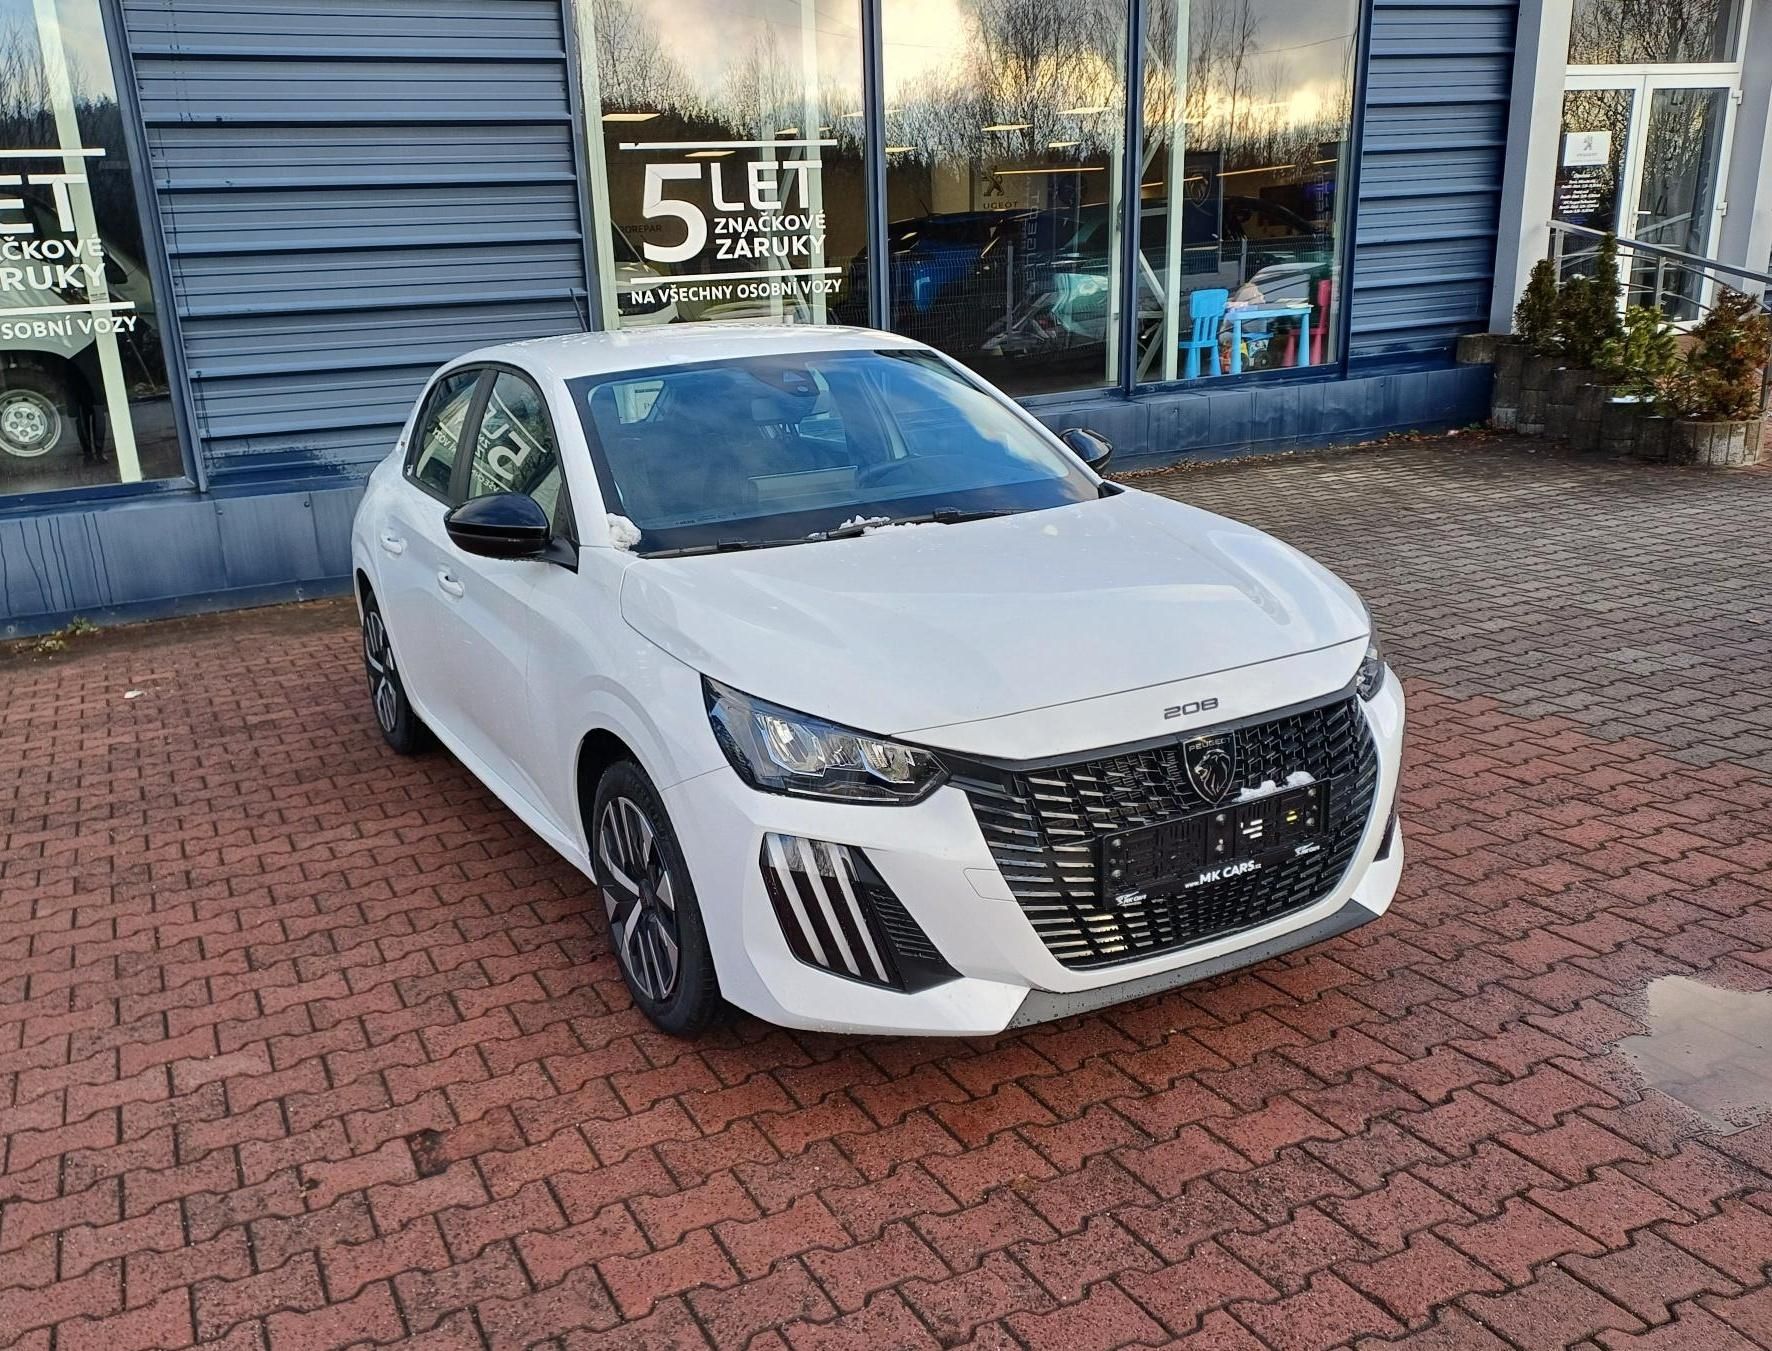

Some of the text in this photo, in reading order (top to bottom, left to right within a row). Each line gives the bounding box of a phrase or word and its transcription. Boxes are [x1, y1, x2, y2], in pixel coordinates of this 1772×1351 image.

[642, 160, 823, 263] 5 LET
[713, 209, 827, 235] ZNAČKOVÉ
[0, 233, 105, 261] ČKOVÉ
[715, 230, 826, 260] ZÁRUKY
[0, 262, 106, 292] RUKY
[631, 277, 843, 305] NA VŠECHNY OSOBNÍ VOZY
[2, 315, 137, 340] SOBNÍ VOZY
[1163, 697, 1219, 720] 208
[1188, 737, 1231, 752] PEUGEOT
